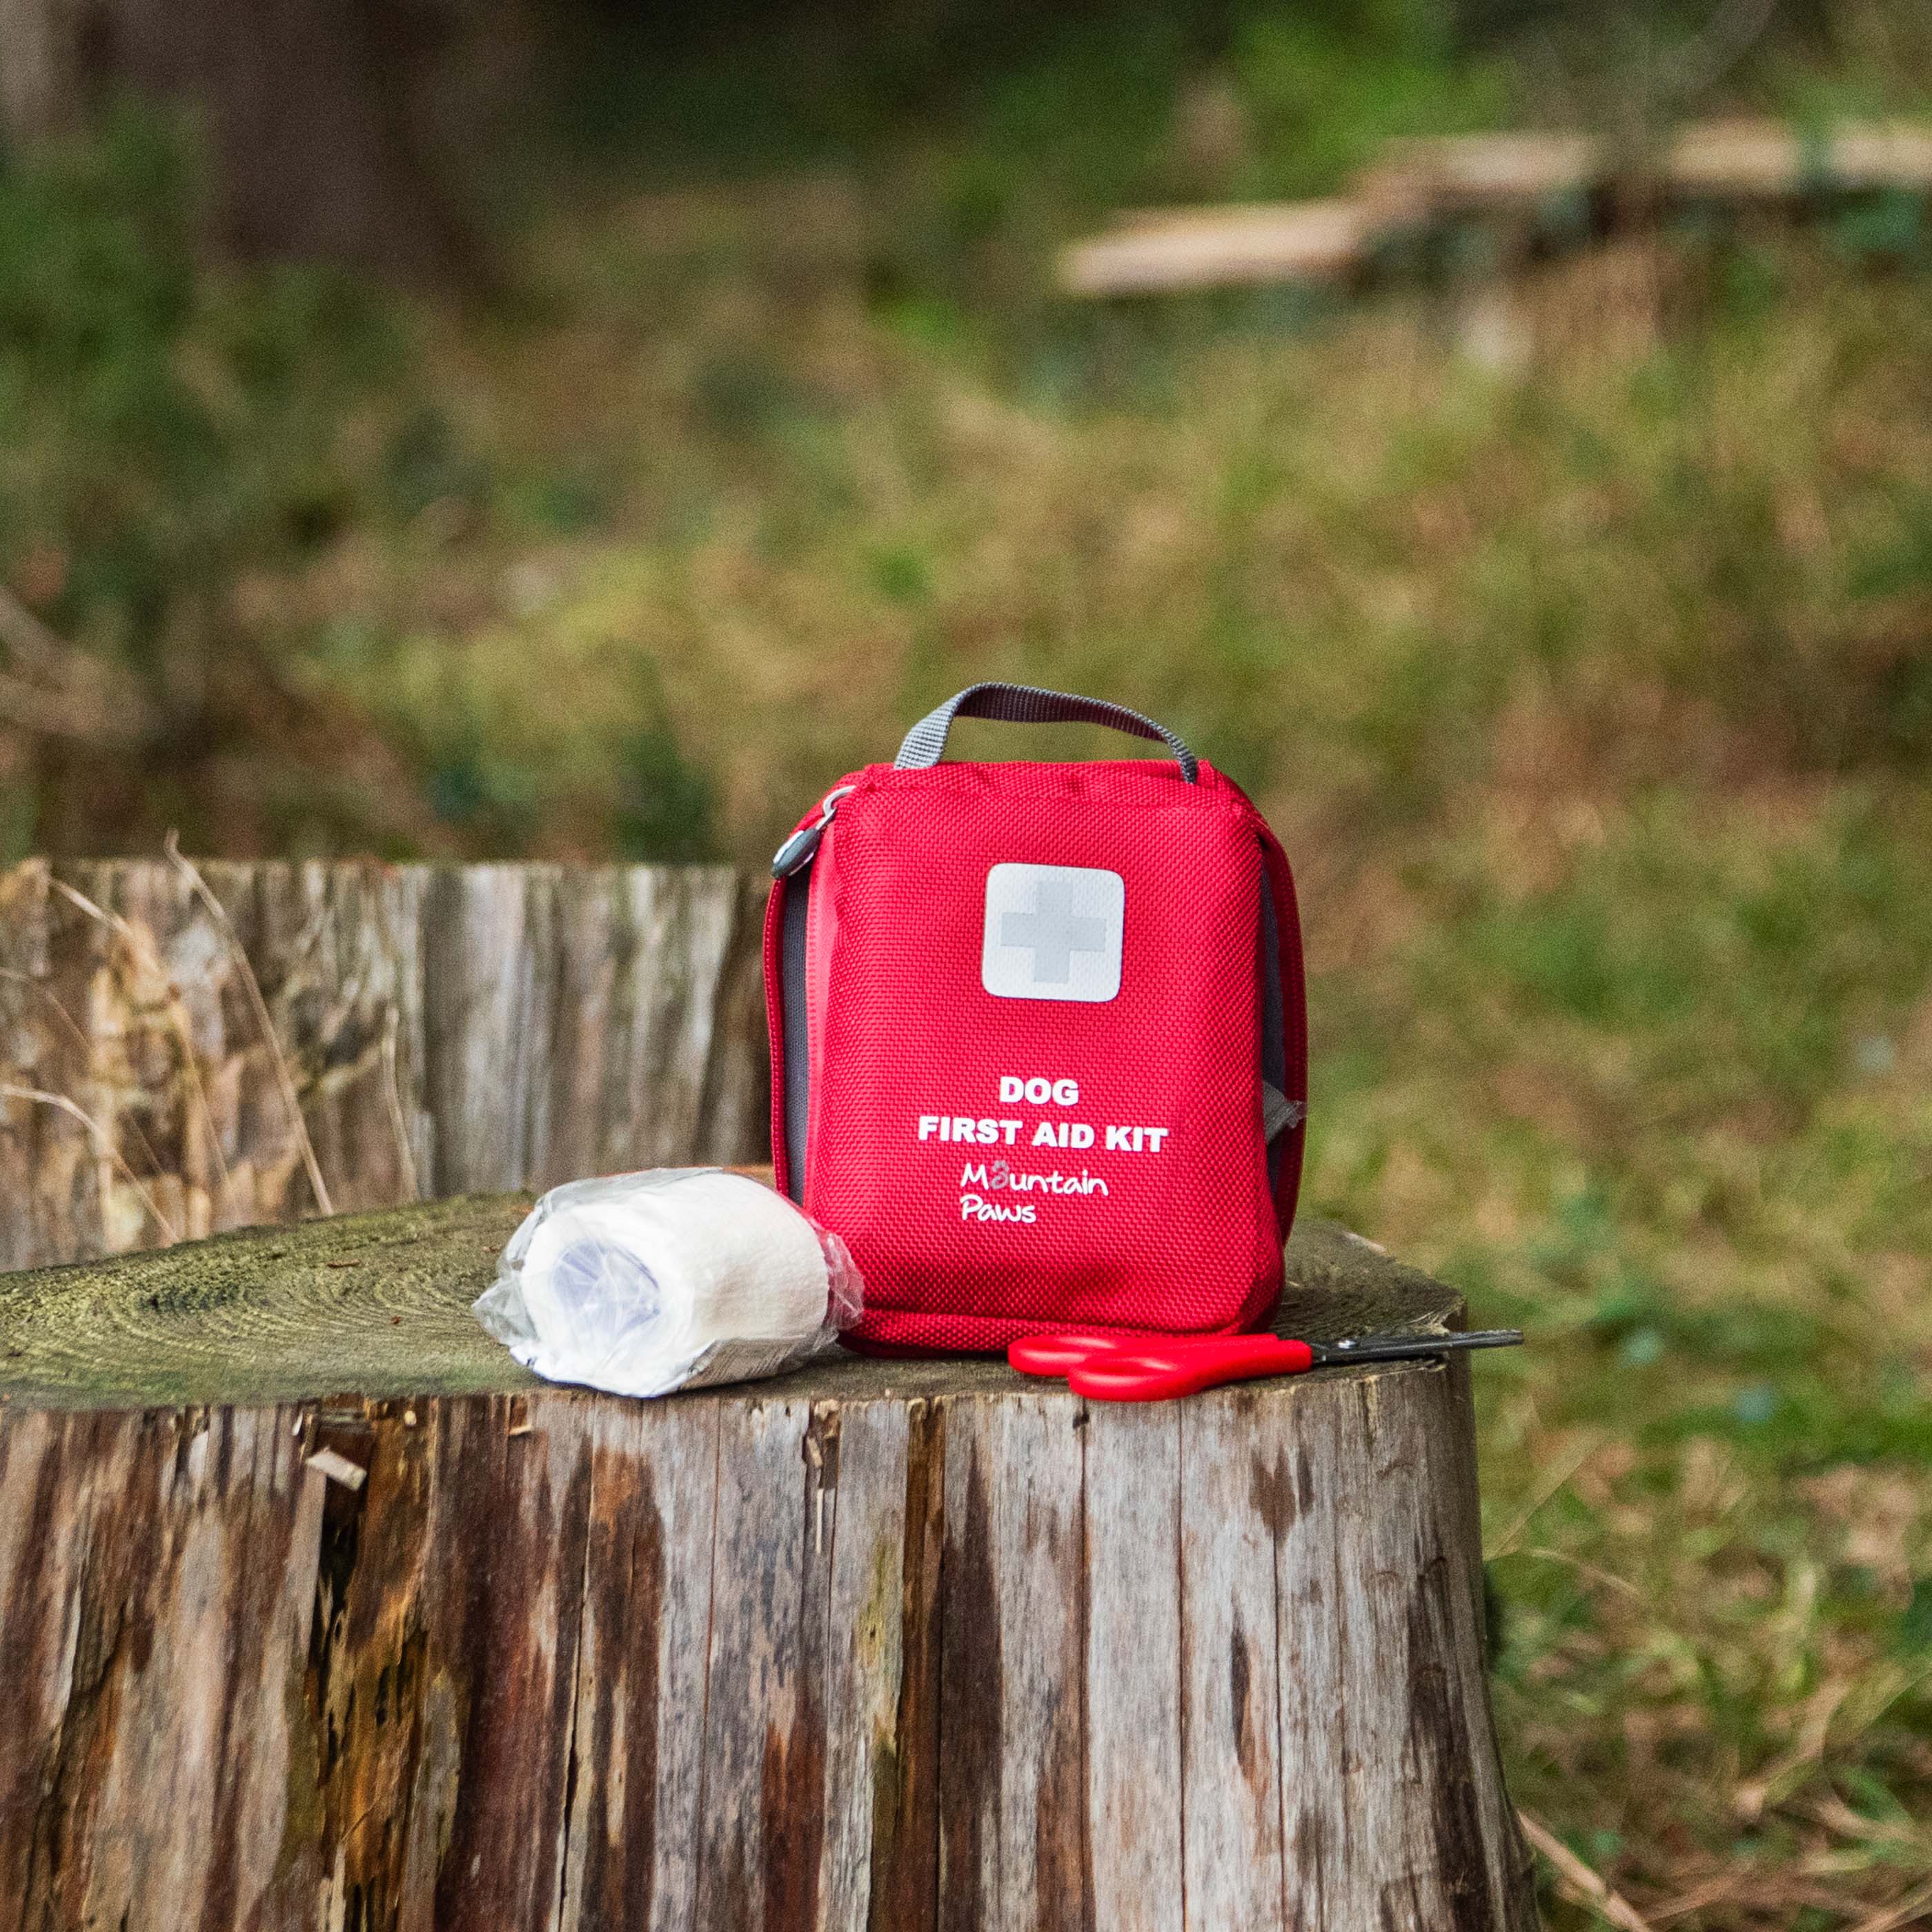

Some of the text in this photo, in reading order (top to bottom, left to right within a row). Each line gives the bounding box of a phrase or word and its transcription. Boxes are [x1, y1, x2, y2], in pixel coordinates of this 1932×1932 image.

[999, 1076, 1079, 1106] DOG
[918, 1115, 1169, 1153] FIRST AID KIT
[960, 1159, 1109, 1196] Mountain
[959, 1193, 1037, 1224] Paws
